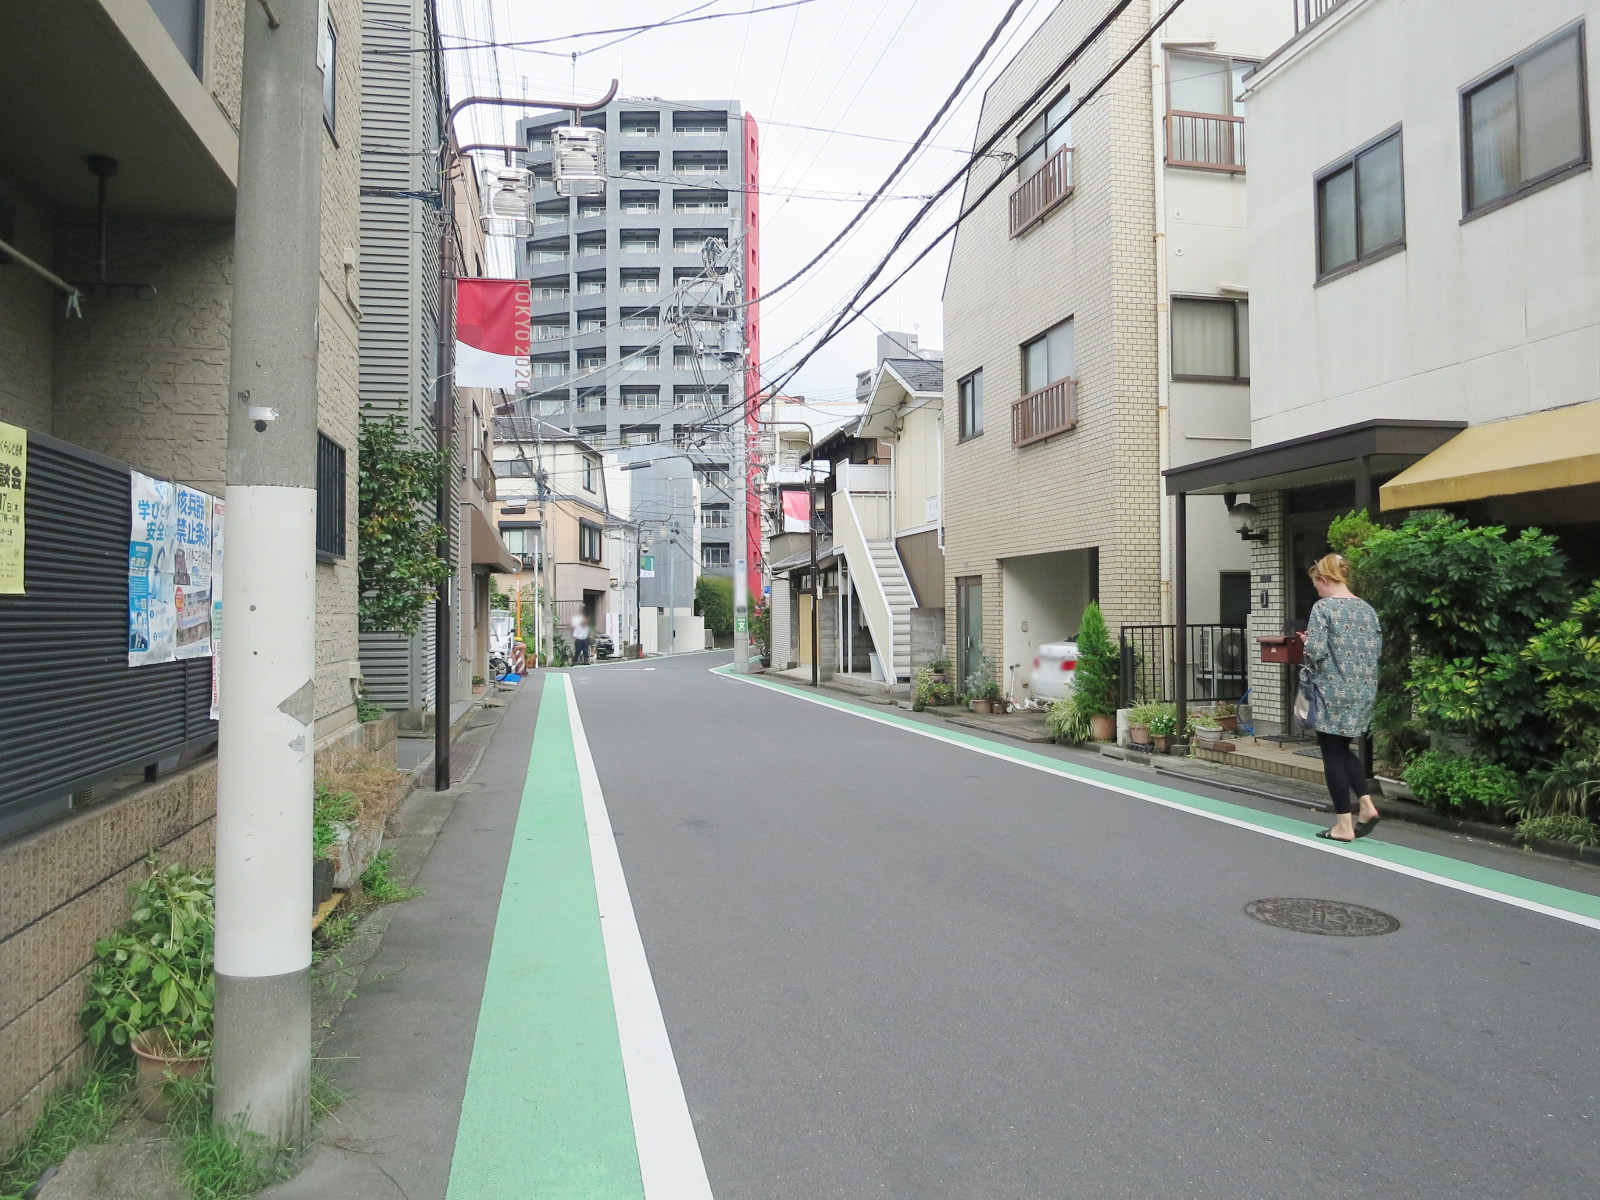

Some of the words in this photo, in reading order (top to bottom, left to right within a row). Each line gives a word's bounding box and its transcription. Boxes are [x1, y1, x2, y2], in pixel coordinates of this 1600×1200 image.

[514, 279, 531, 341] TOKYO
[514, 345, 531, 390] 2020
[177, 490, 205, 520] 核兵器
[176, 517, 210, 549] 禁止条約
